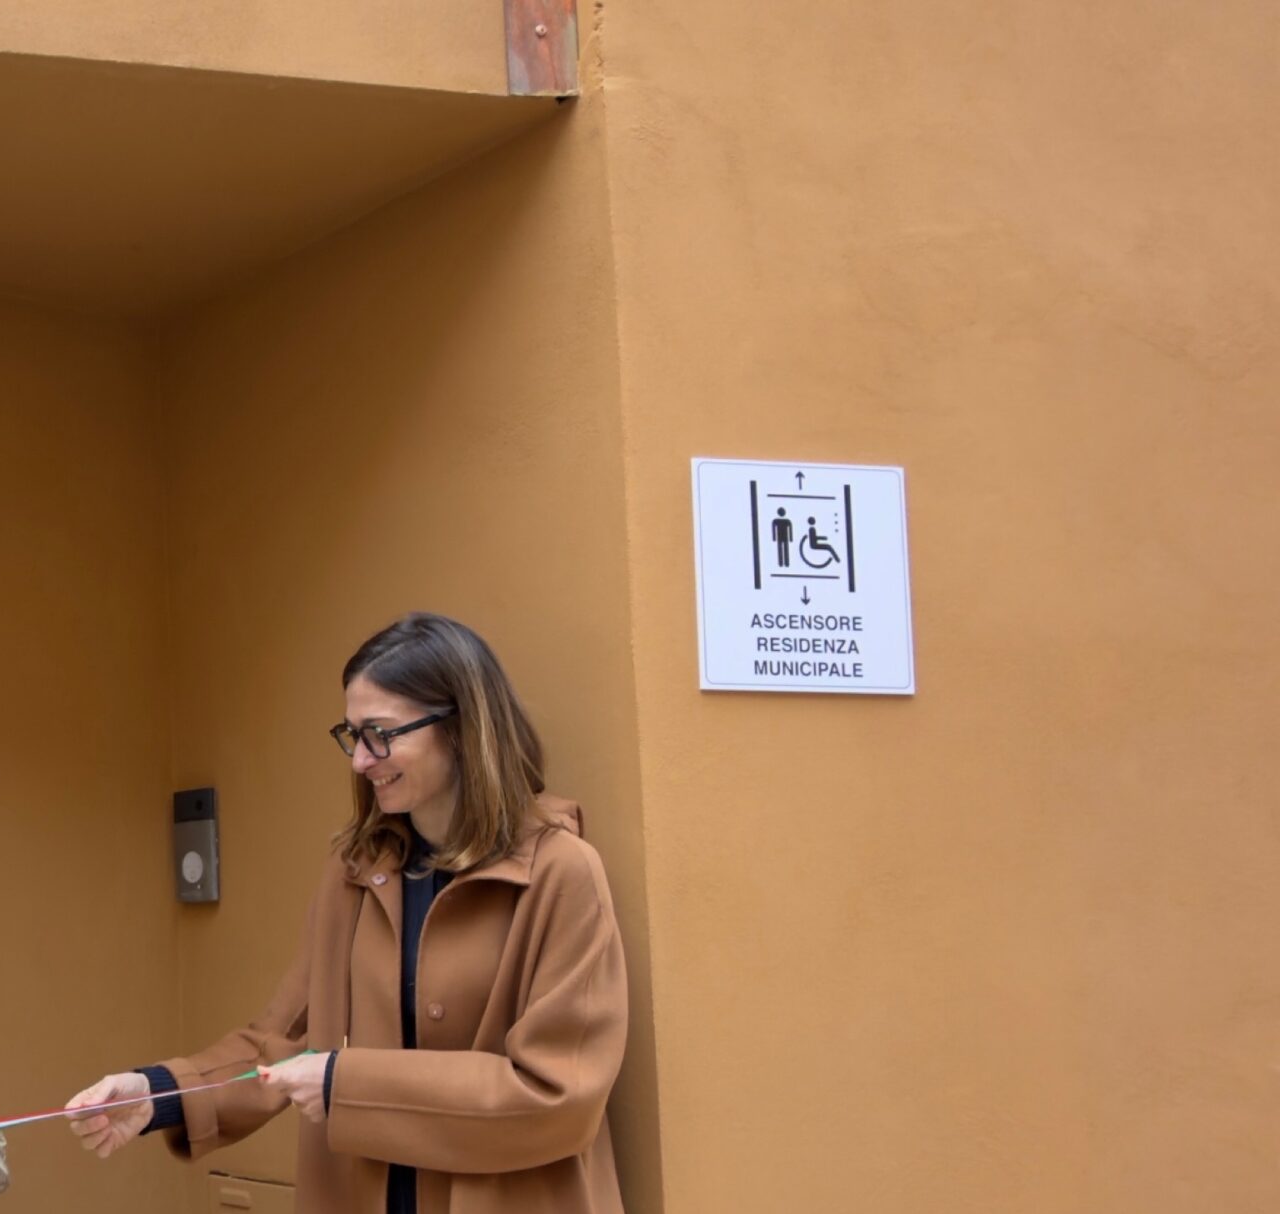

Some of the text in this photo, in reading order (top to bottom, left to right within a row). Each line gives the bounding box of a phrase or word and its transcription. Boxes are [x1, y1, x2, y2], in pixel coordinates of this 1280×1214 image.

[751, 613, 863, 631] ASCENSORE
[757, 637, 860, 654] RESIDENZA
[754, 660, 863, 677] MUNICIPALE
